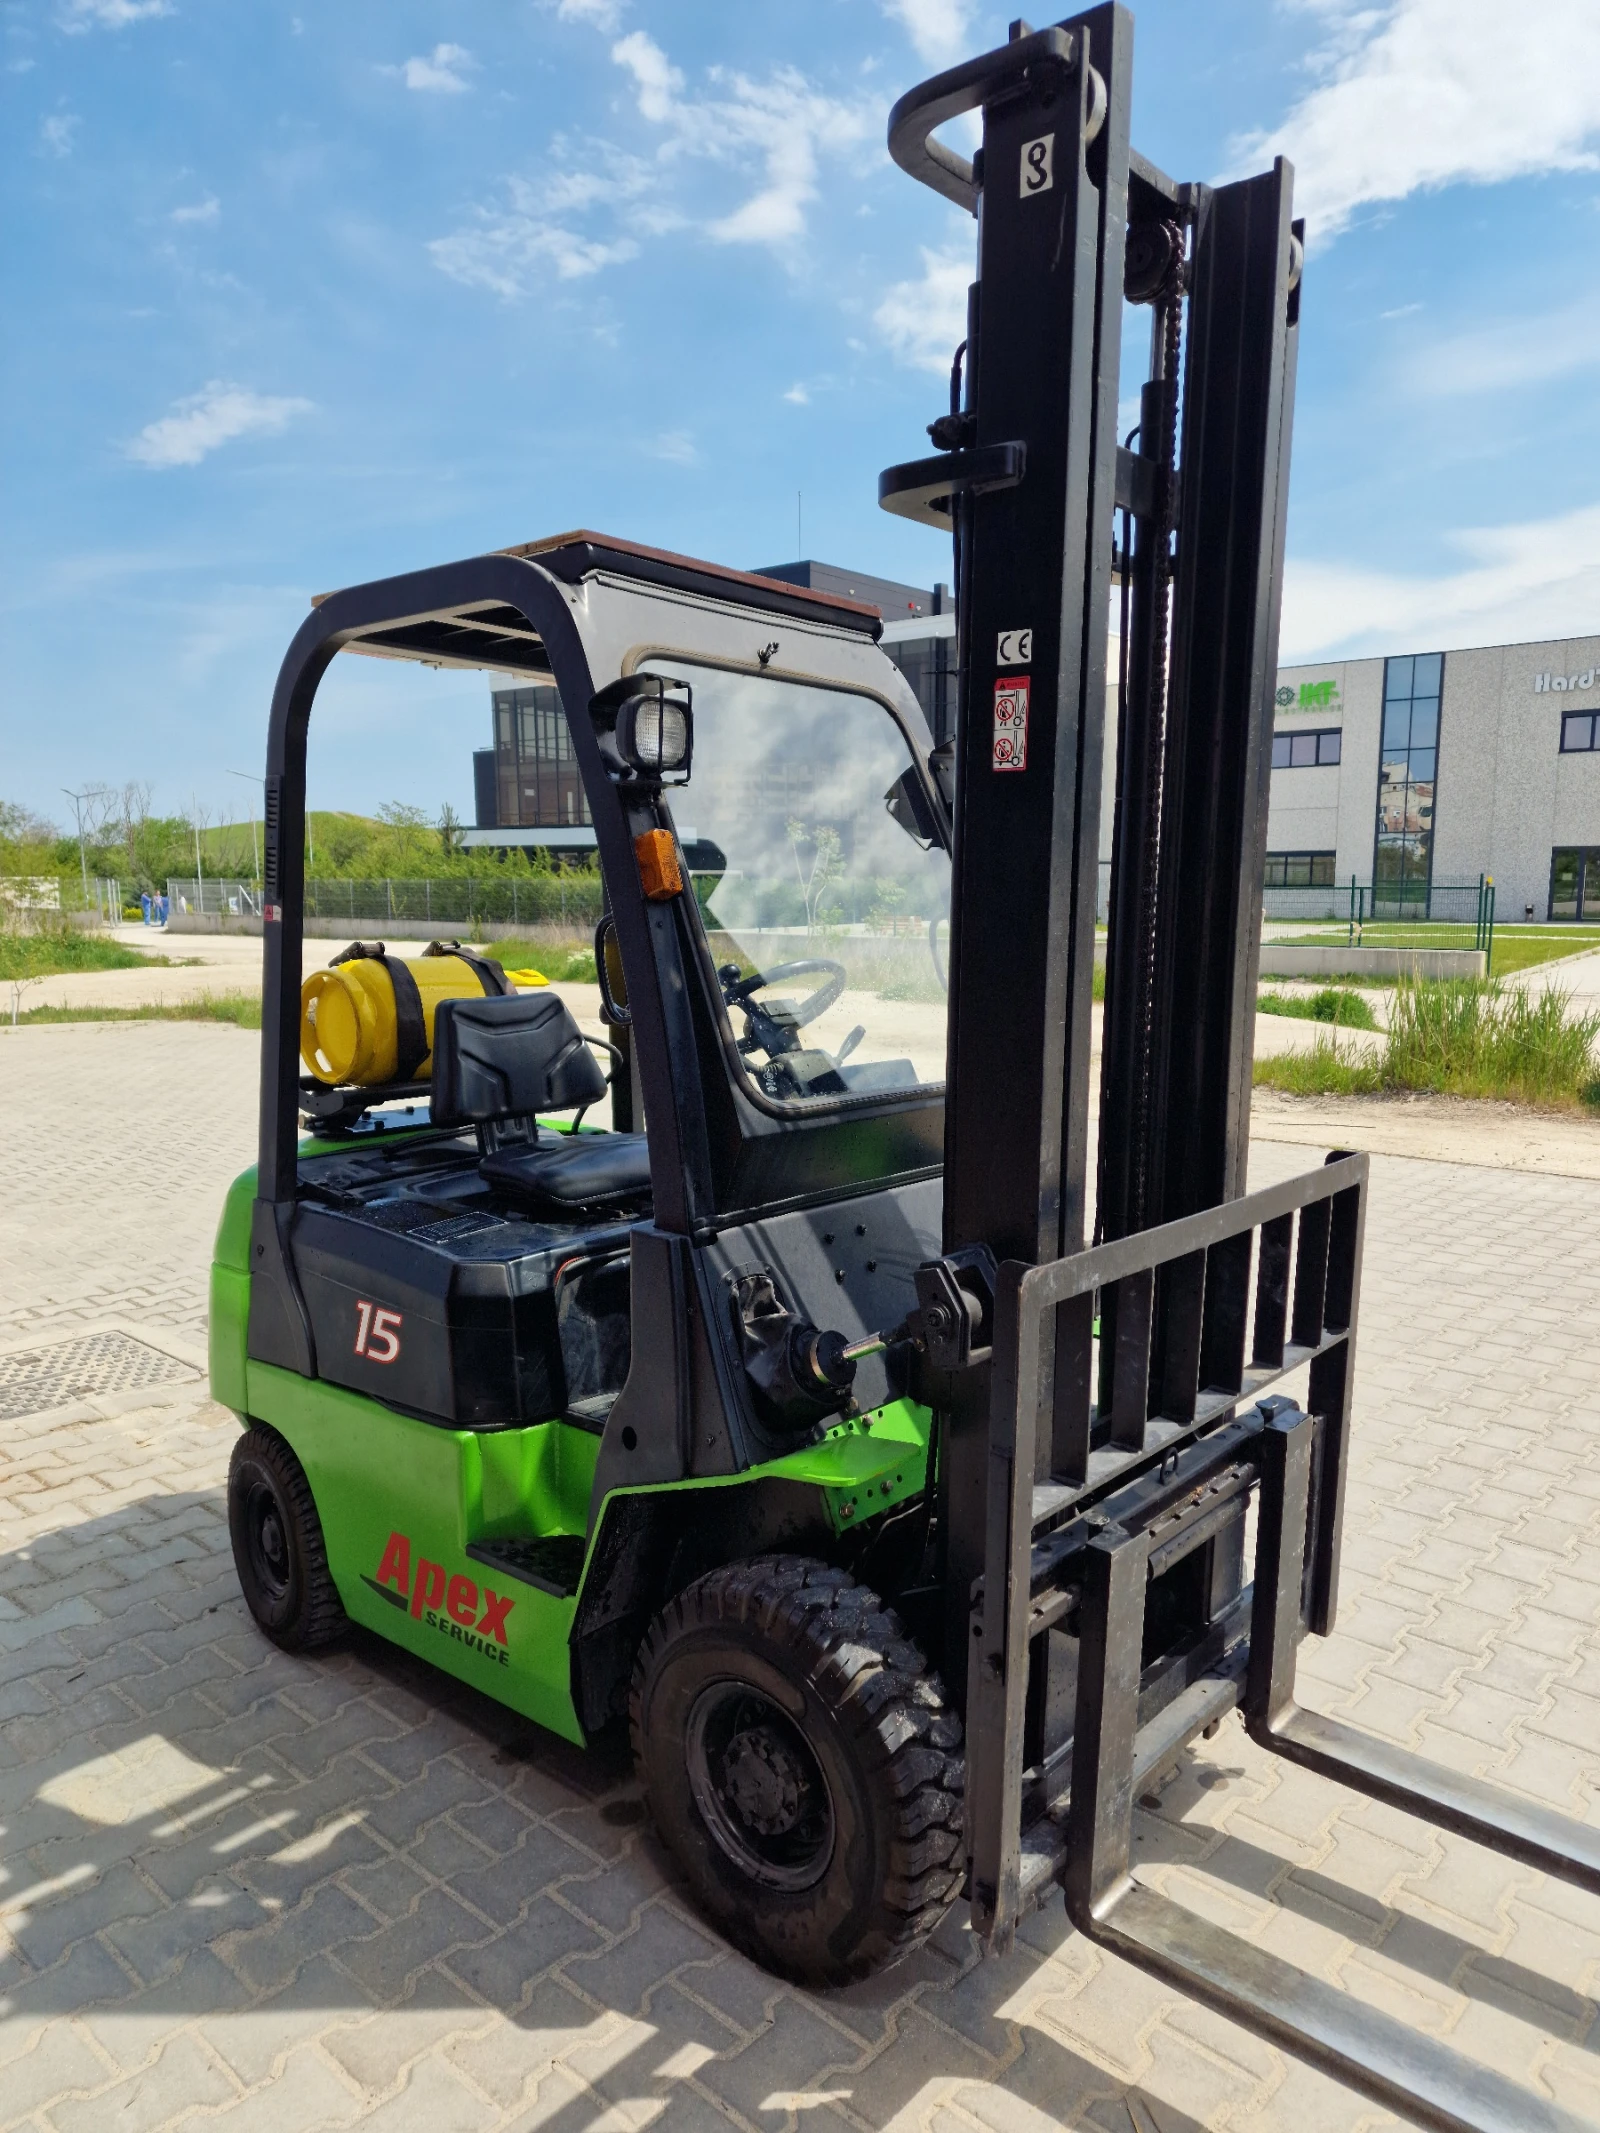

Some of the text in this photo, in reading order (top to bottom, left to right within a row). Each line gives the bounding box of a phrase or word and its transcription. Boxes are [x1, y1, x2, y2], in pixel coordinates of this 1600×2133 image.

[354, 1300, 402, 1365] 15
[375, 1531, 516, 1647] Apex
[425, 1610, 510, 1667] SERVICE
